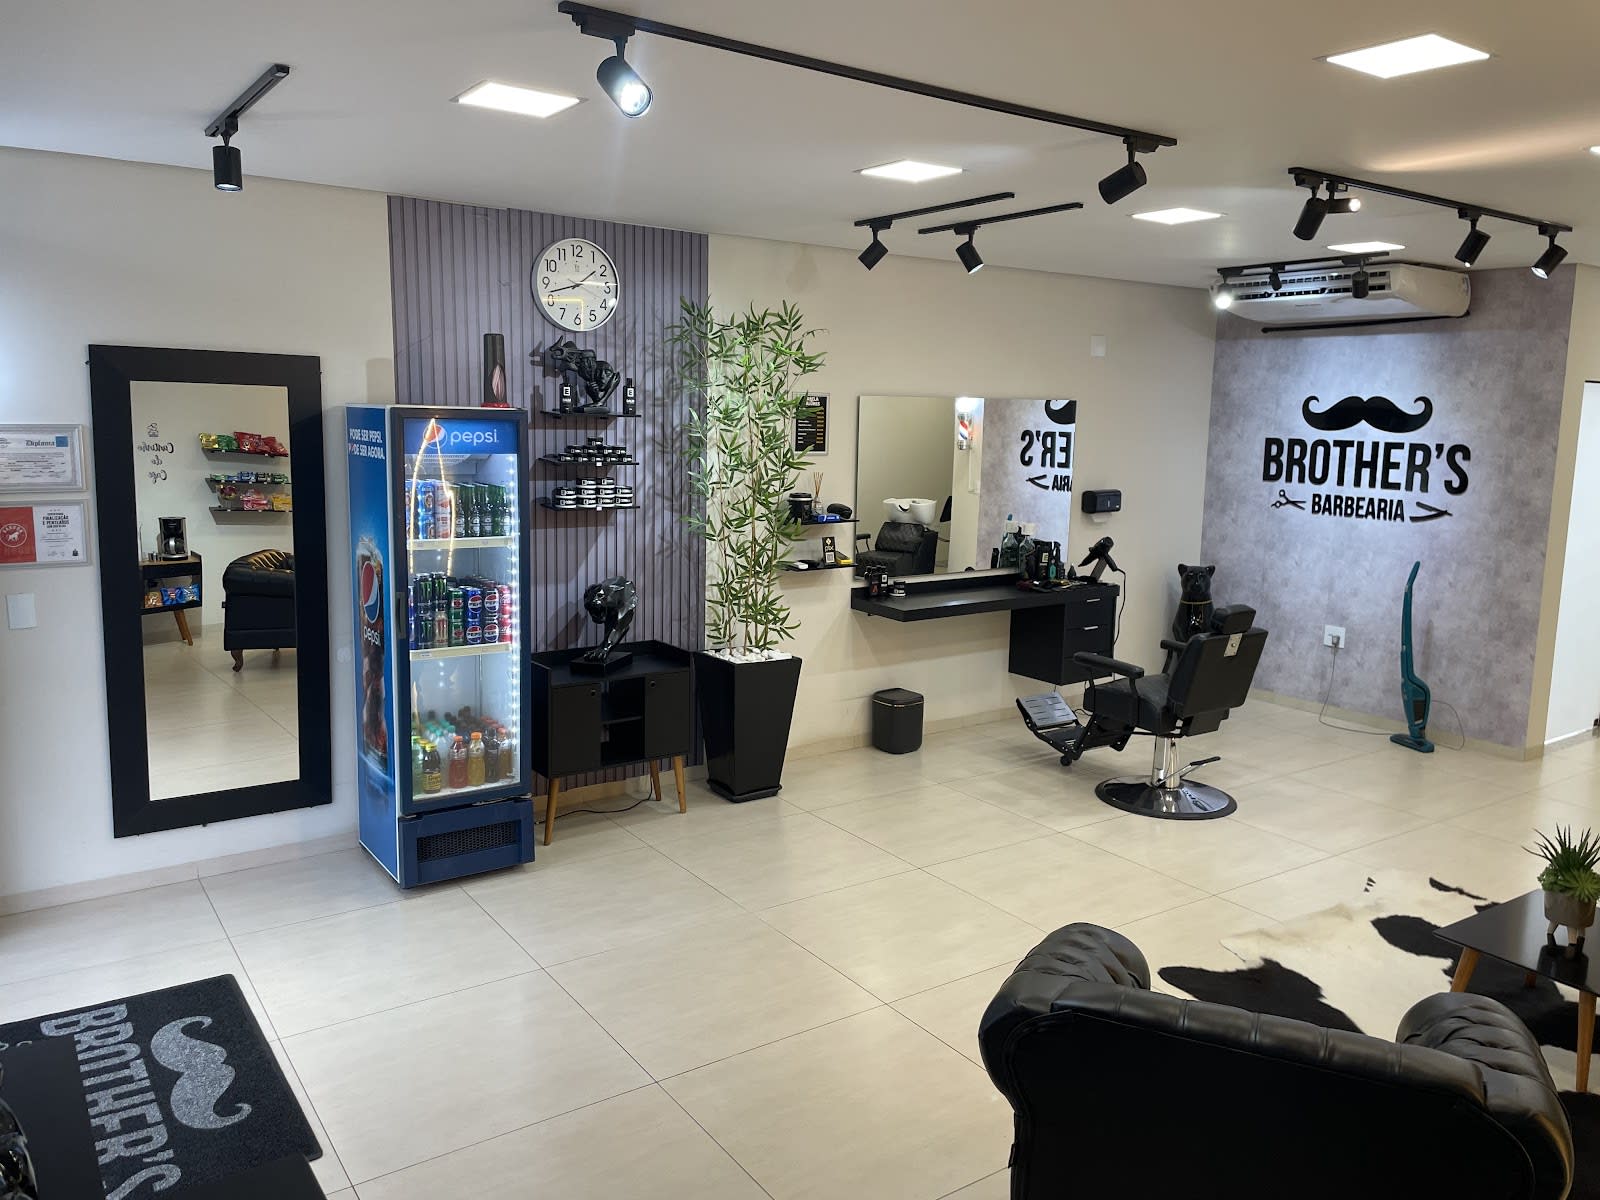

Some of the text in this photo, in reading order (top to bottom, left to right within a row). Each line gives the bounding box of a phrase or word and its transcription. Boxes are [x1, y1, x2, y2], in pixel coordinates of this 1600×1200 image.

[557, 247, 567, 261] 11
[570, 244, 583, 258] 12
[591, 250, 595, 264] 1
[544, 259, 557, 273] 10
[599, 264, 607, 277] 2
[542, 276, 550, 289] 9
[603, 281, 611, 294] 3
[599, 298, 607, 311] 4
[559, 307, 566, 320] 7
[573, 313, 582, 325] 6
[589, 310, 597, 322] 5
[349, 428, 361, 440] PODE
[361, 429, 369, 442] SER
[450, 429, 497, 447] pepsi
[360, 444, 368, 457] SER
[1262, 437, 1472, 496] BROTHER'S
[1311, 493, 1405, 522] BARBEARIA
[363, 625, 381, 647] pepsi
